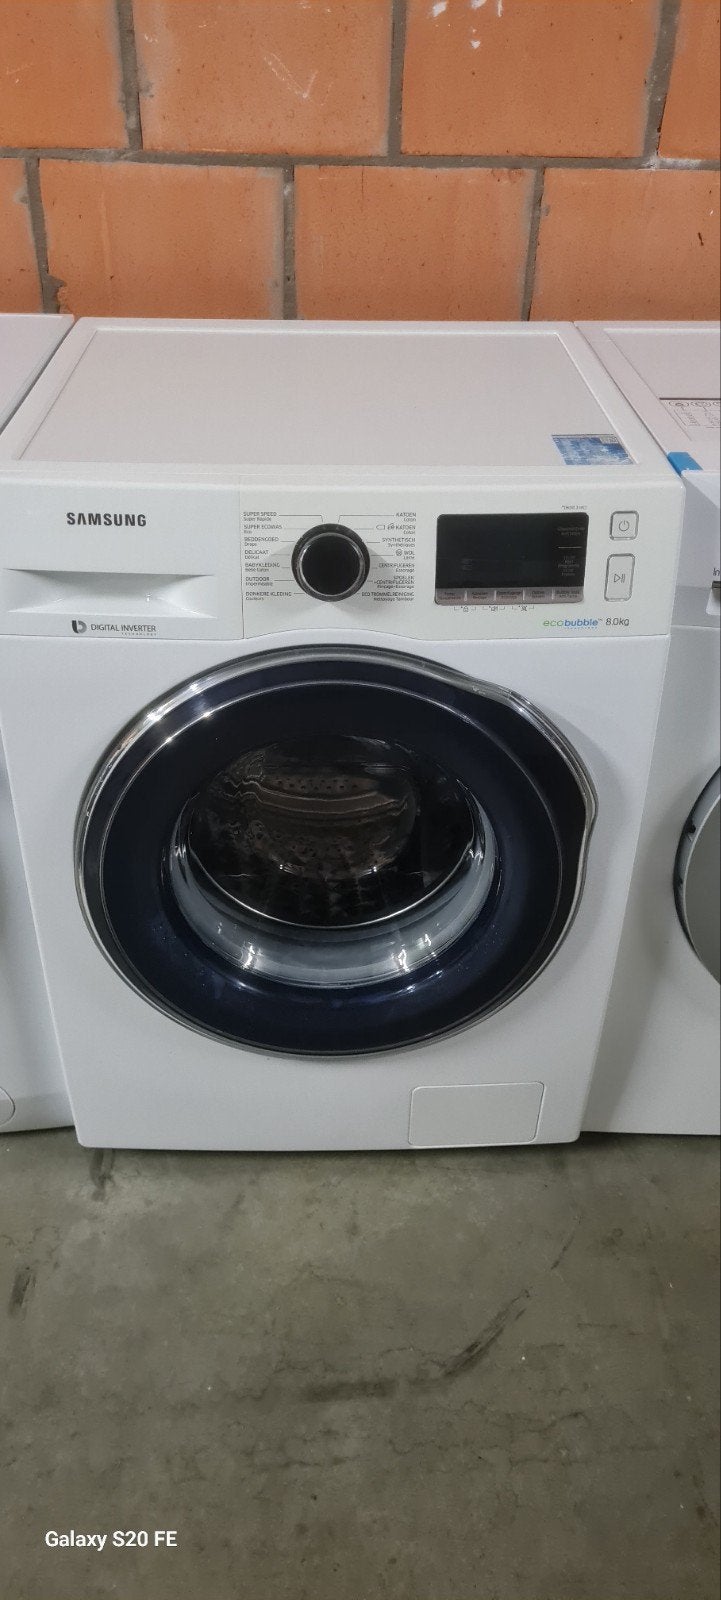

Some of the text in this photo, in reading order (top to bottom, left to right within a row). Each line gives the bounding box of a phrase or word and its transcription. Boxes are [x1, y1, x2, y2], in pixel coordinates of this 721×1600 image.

[66, 512, 147, 527] SAMSUNG
[605, 617, 630, 627] 8.0kg
[90, 623, 157, 633] DIGITAL INVERTER
